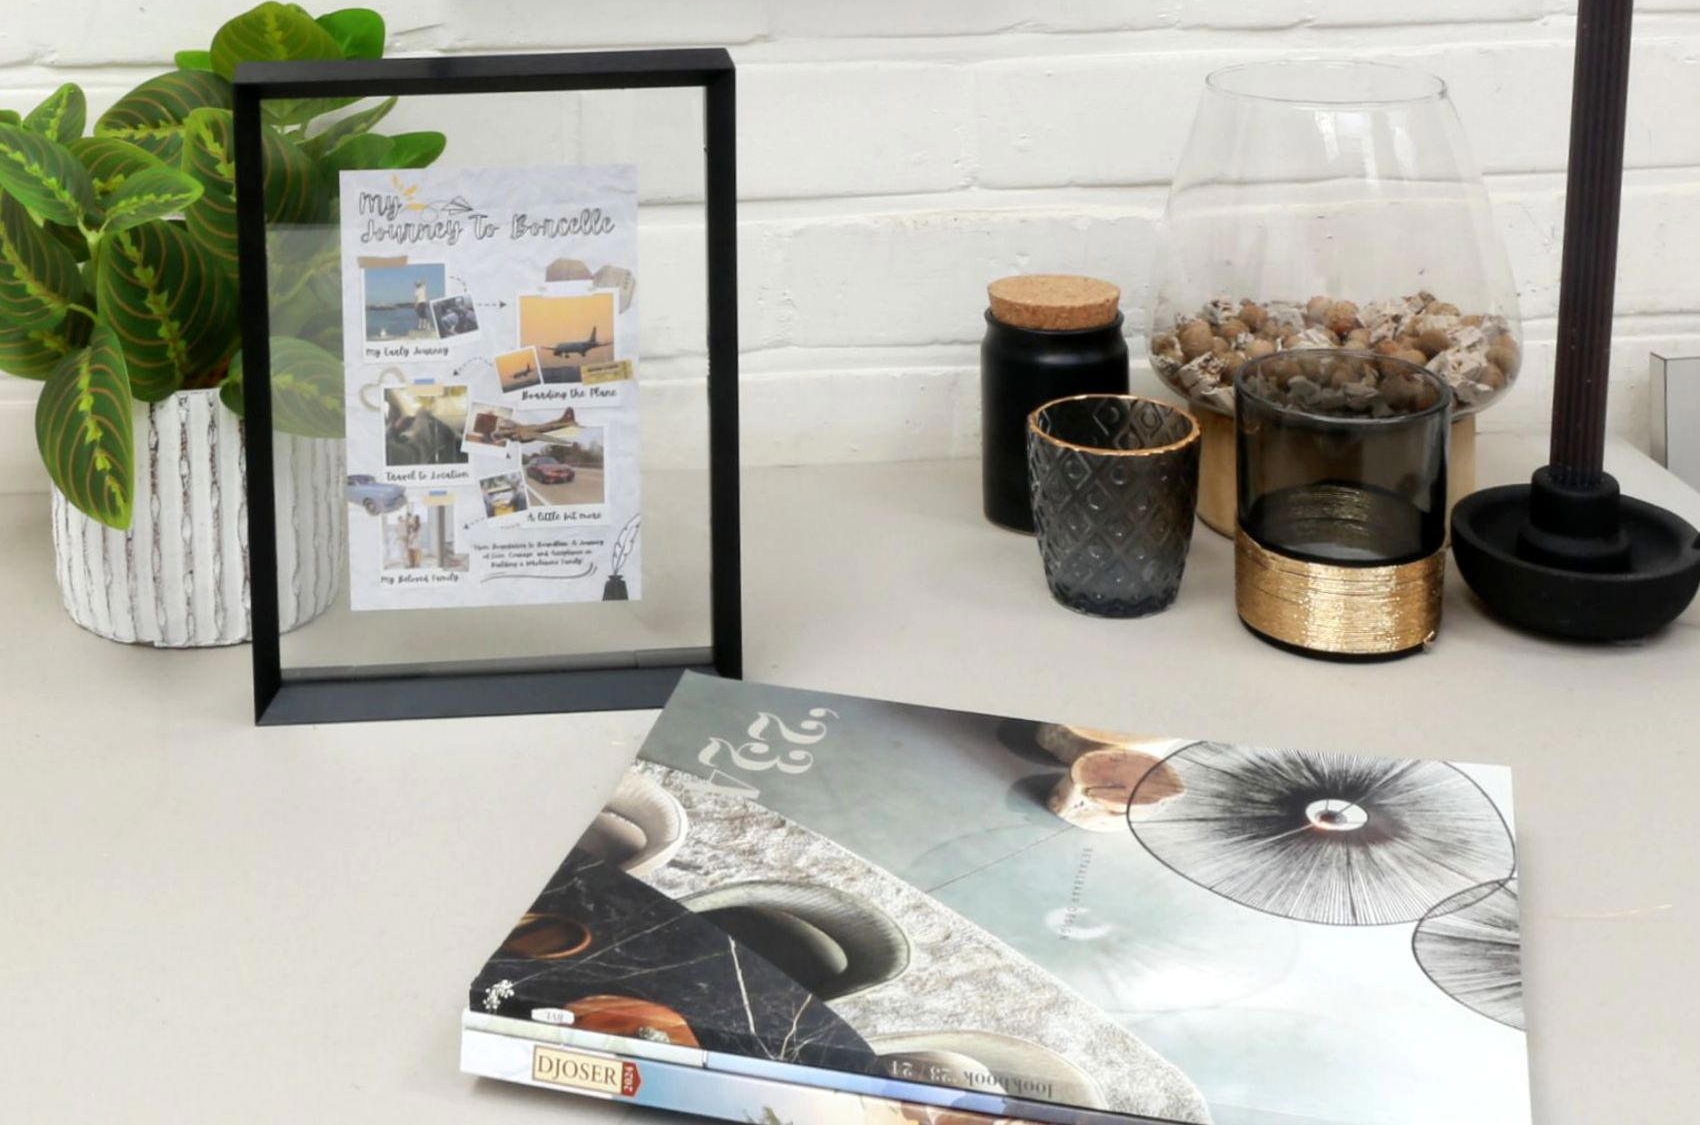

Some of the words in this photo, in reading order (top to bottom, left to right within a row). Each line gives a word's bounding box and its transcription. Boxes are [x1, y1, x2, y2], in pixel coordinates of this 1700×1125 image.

[359, 191, 403, 221] My
[360, 219, 464, 246] Journey
[467, 213, 501, 240] To
[537, 1054, 618, 1087] DJOSER
[622, 1064, 634, 1093] 2024
[963, 1070, 1053, 1099] lookbook
